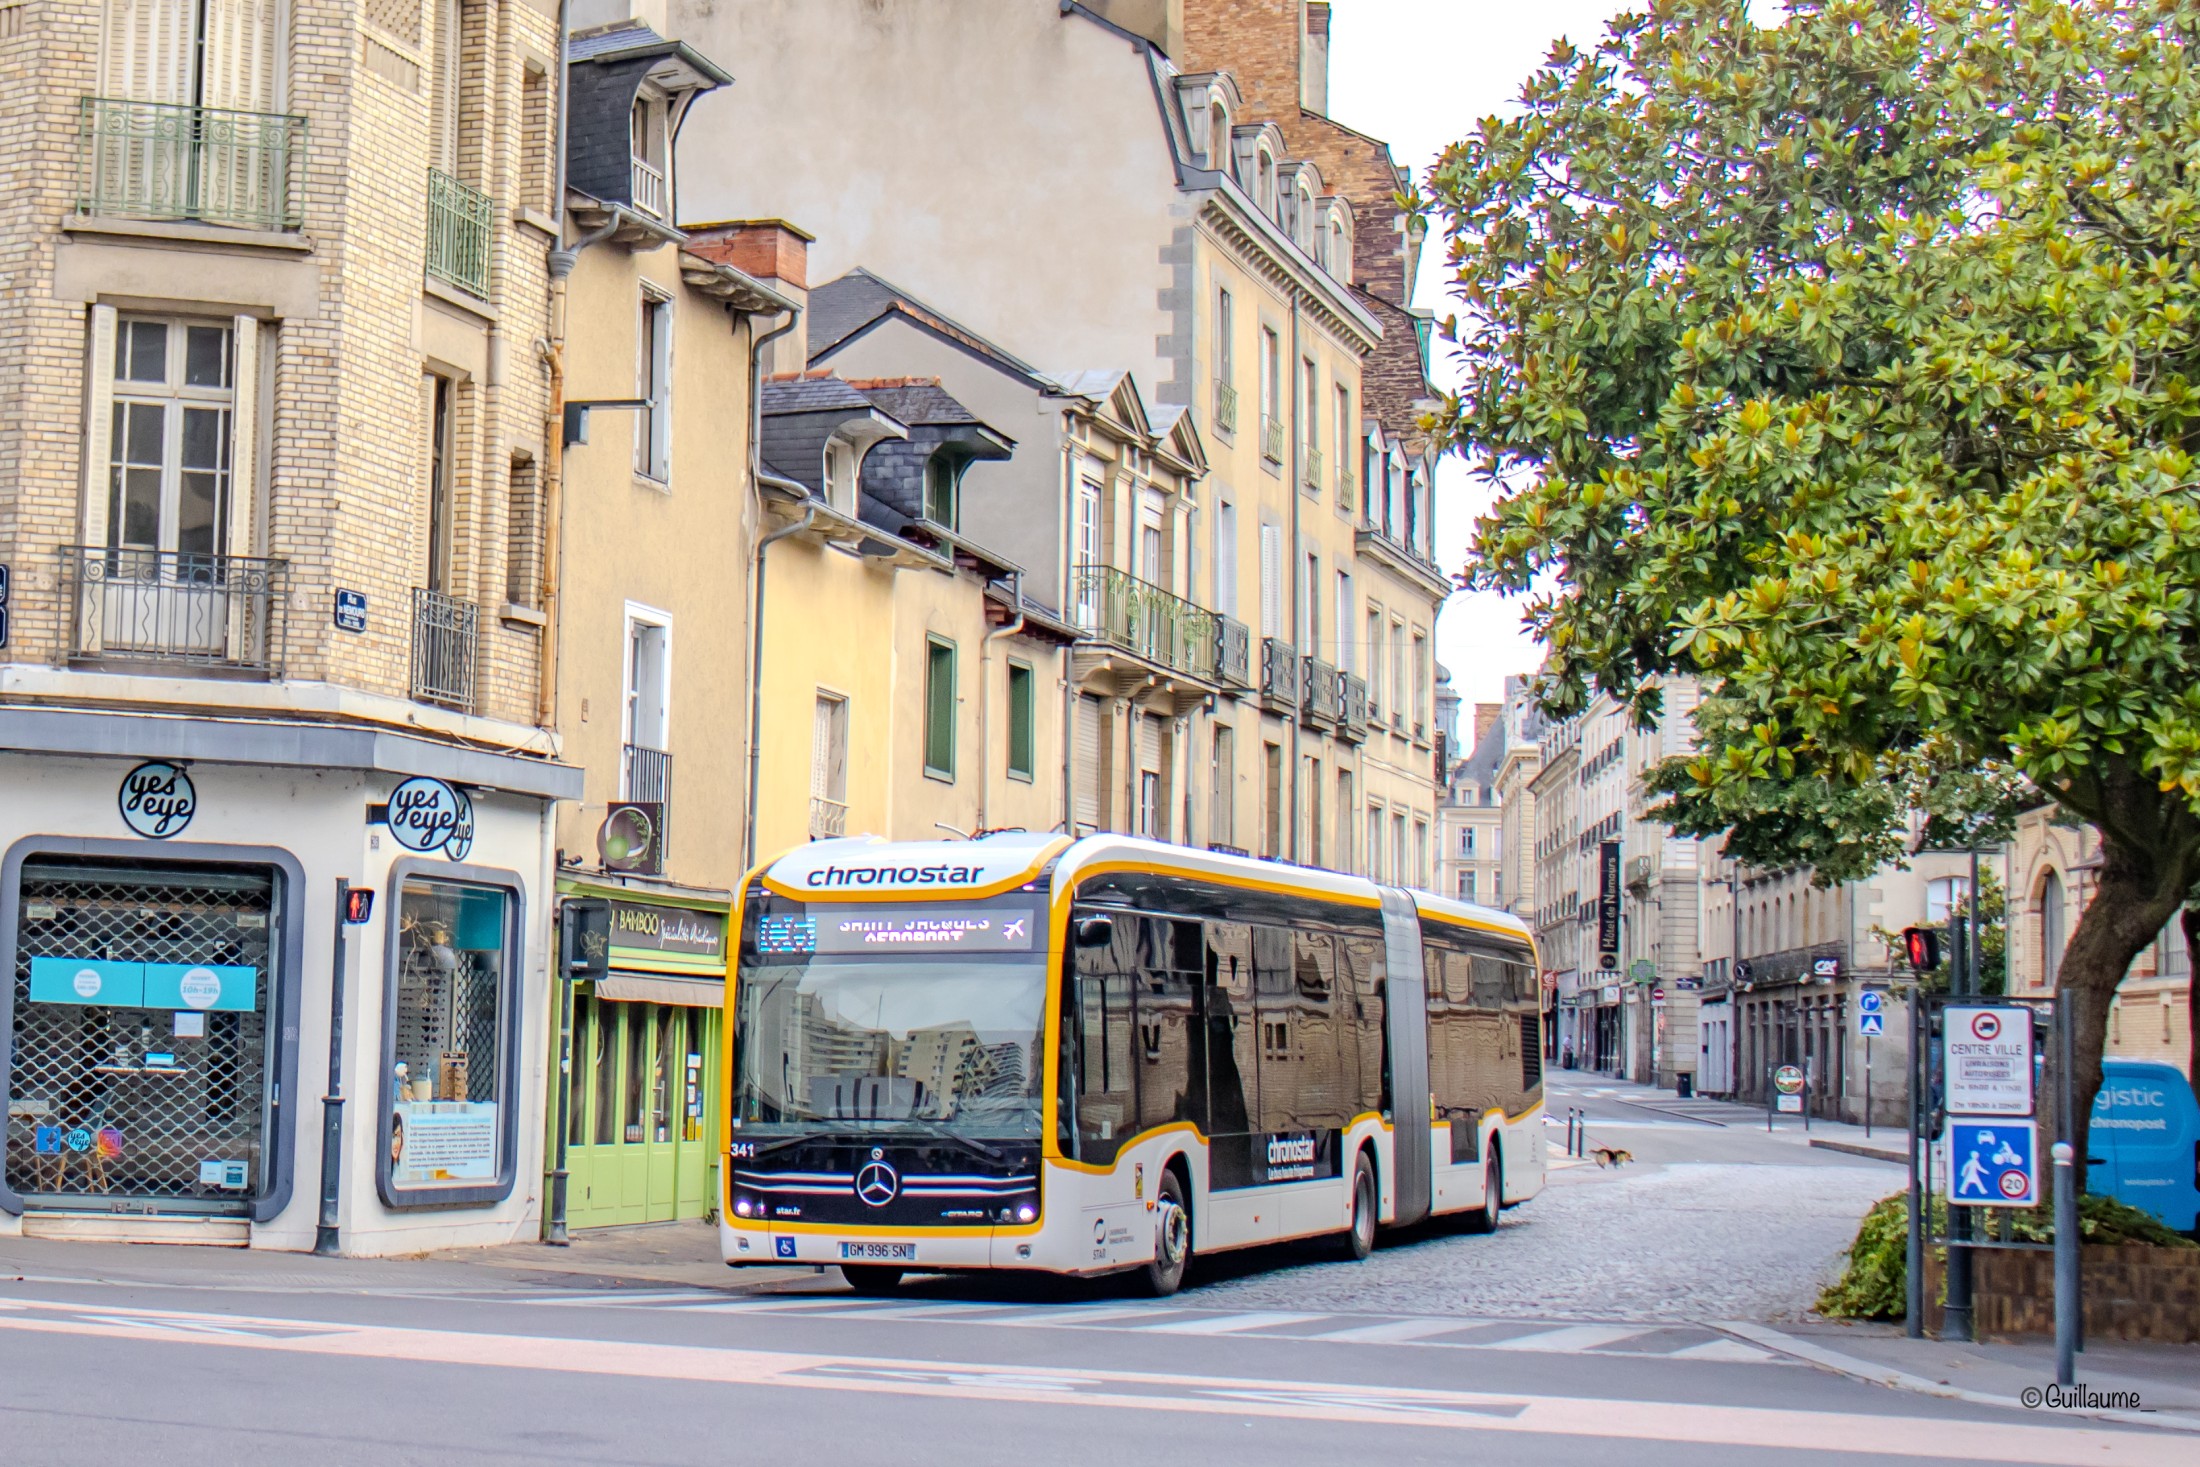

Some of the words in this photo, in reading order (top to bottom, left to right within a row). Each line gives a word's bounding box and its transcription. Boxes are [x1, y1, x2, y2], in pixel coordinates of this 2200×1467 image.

[127, 775, 176, 812] yes
[144, 797, 192, 834] eye
[394, 790, 440, 826] yes
[410, 811, 455, 847] eye
[452, 824, 471, 857] ye
[806, 863, 984, 886] chronostar
[1603, 857, 1616, 904] Nemours
[619, 909, 659, 935] BAMBOO
[1605, 907, 1615, 918] de
[1602, 920, 1615, 948] Hôtel
[1951, 1044, 1991, 1055] CENTRE
[1995, 1044, 2022, 1055] VILLE
[1965, 1060, 2010, 1068] LIVRAISONS
[2095, 1086, 2164, 1111] gistic
[2090, 1116, 2166, 1131] chronopost
[730, 1143, 755, 1157] 341
[1268, 1134, 1314, 1164] chronostar
[2004, 1178, 2023, 1190] 20
[775, 1206, 801, 1216] star.fr
